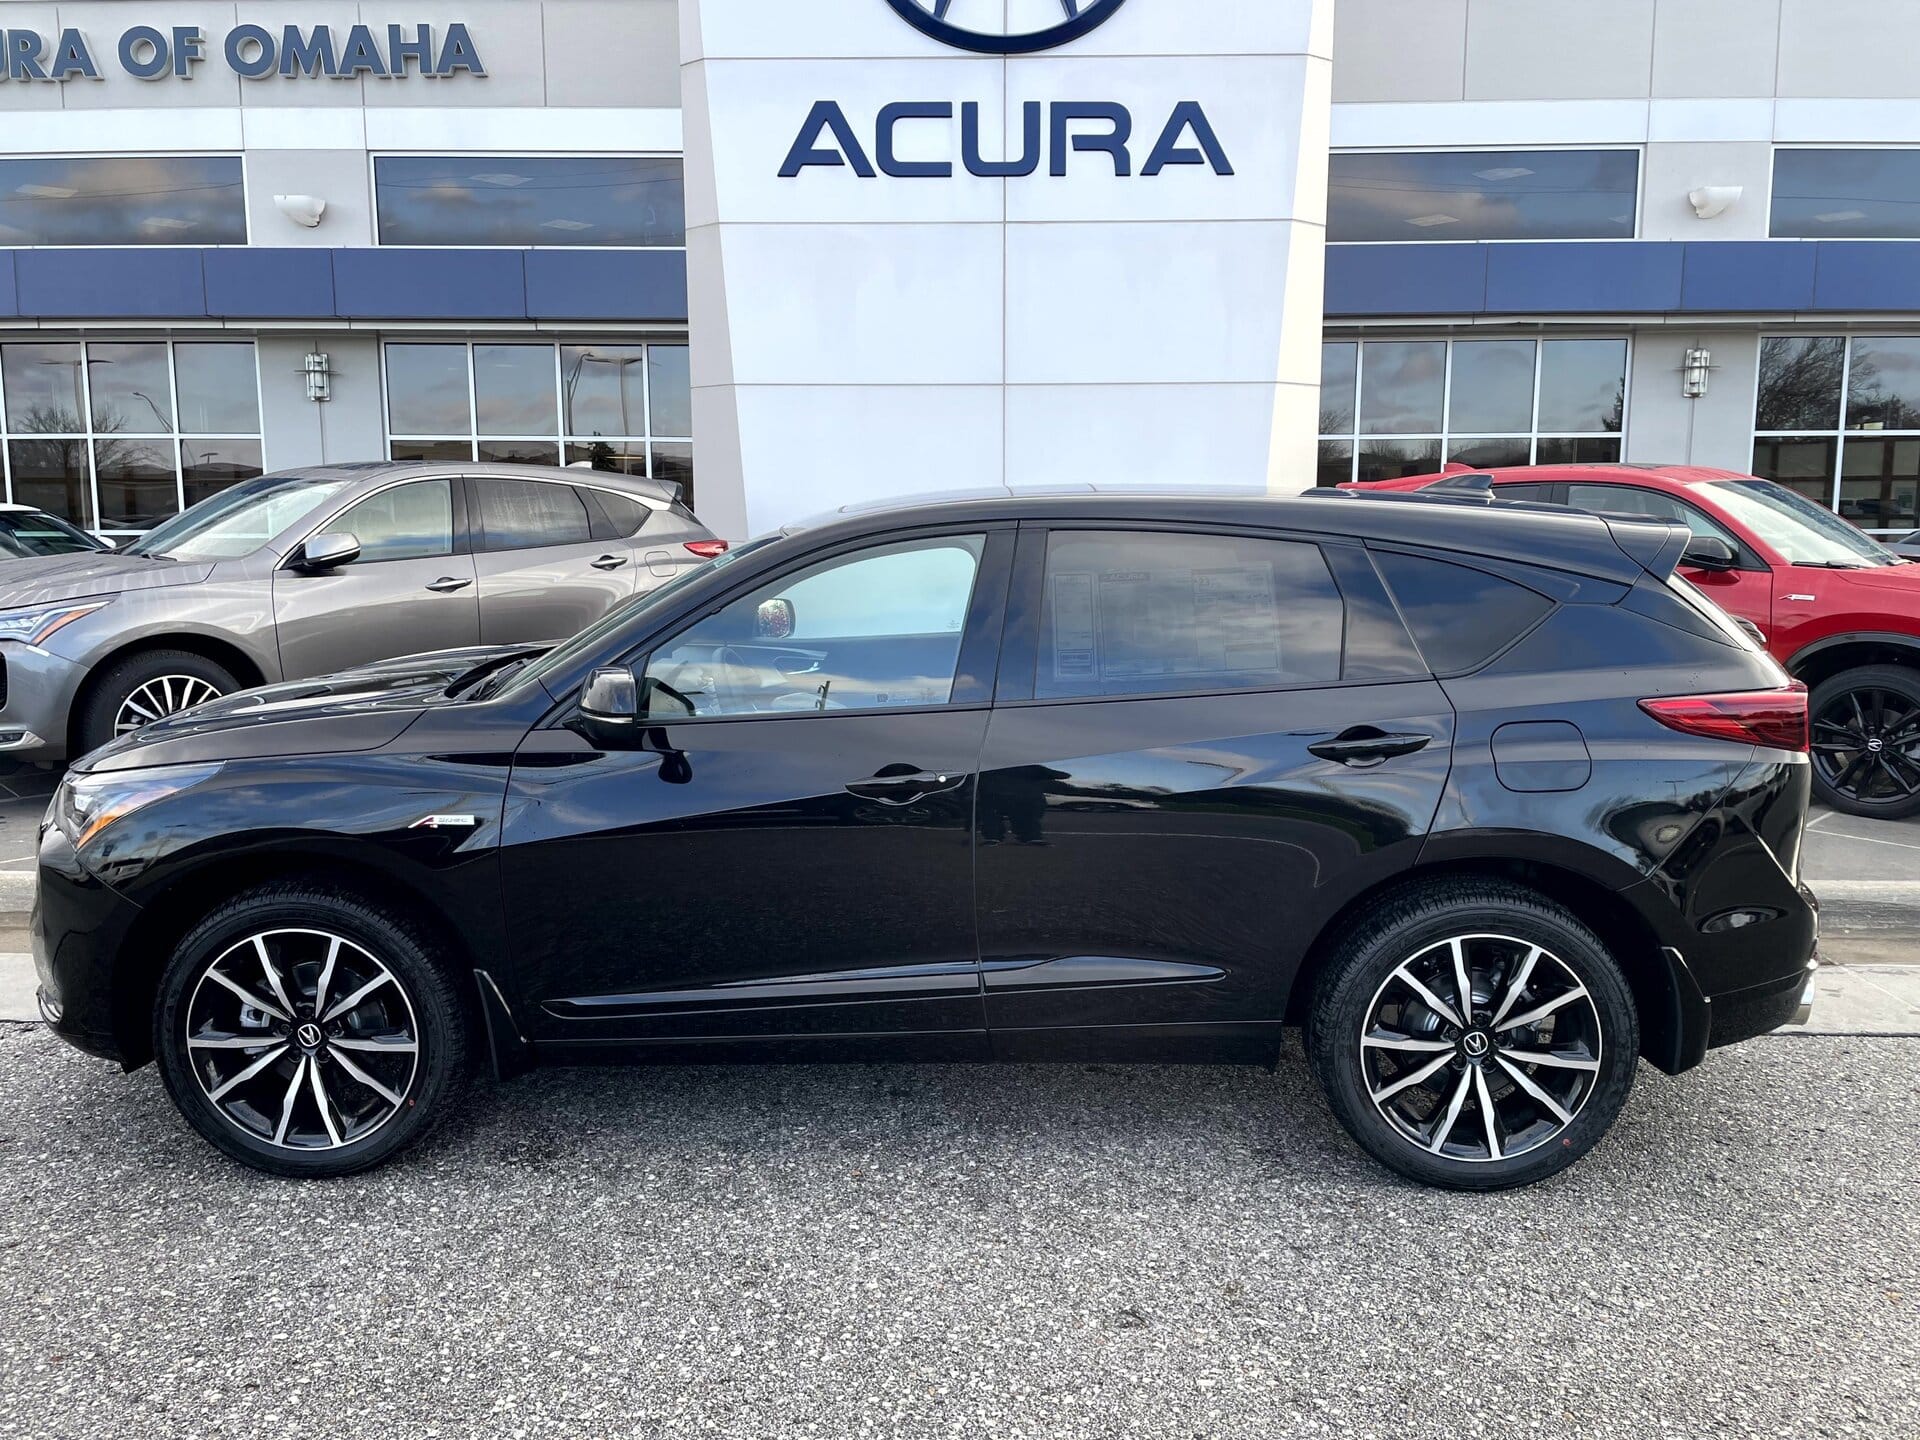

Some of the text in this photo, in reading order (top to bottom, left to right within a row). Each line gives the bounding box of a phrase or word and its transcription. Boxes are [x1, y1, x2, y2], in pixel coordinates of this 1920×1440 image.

[0, 23, 487, 81] RA OF OMAHA
[777, 100, 1234, 177] ACURA
